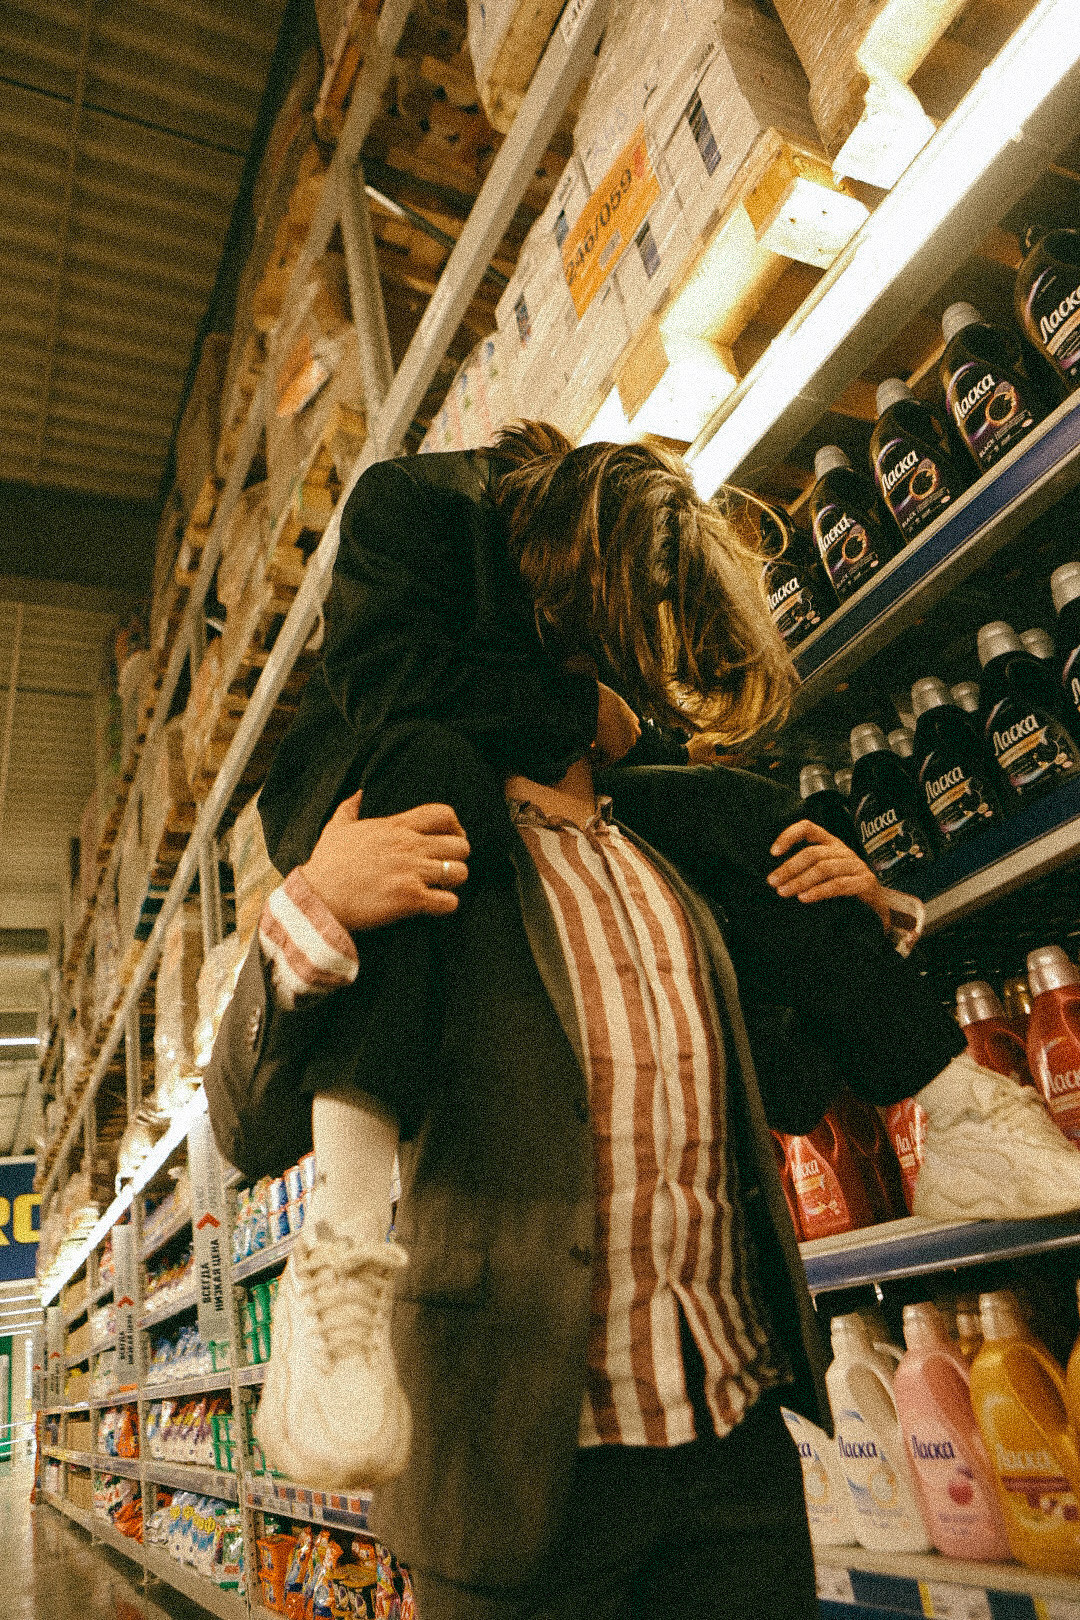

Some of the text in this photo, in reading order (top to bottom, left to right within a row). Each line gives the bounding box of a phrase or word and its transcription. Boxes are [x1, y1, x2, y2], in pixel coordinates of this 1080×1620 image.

[1039, 284, 1080, 344] Ласк
[953, 372, 996, 427] Ласка
[880, 450, 919, 497] Ласка
[992, 713, 1040, 757] Ласка
[924, 766, 965, 804] Ласка
[860, 808, 898, 844] Ласка
[200, 1262, 211, 1303] ВСЕГДА
[210, 1238, 224, 1312] НИЗКАЯ ЦЕНА
[838, 1435, 879, 1459] Ласка
[911, 1435, 956, 1460] Ласка
